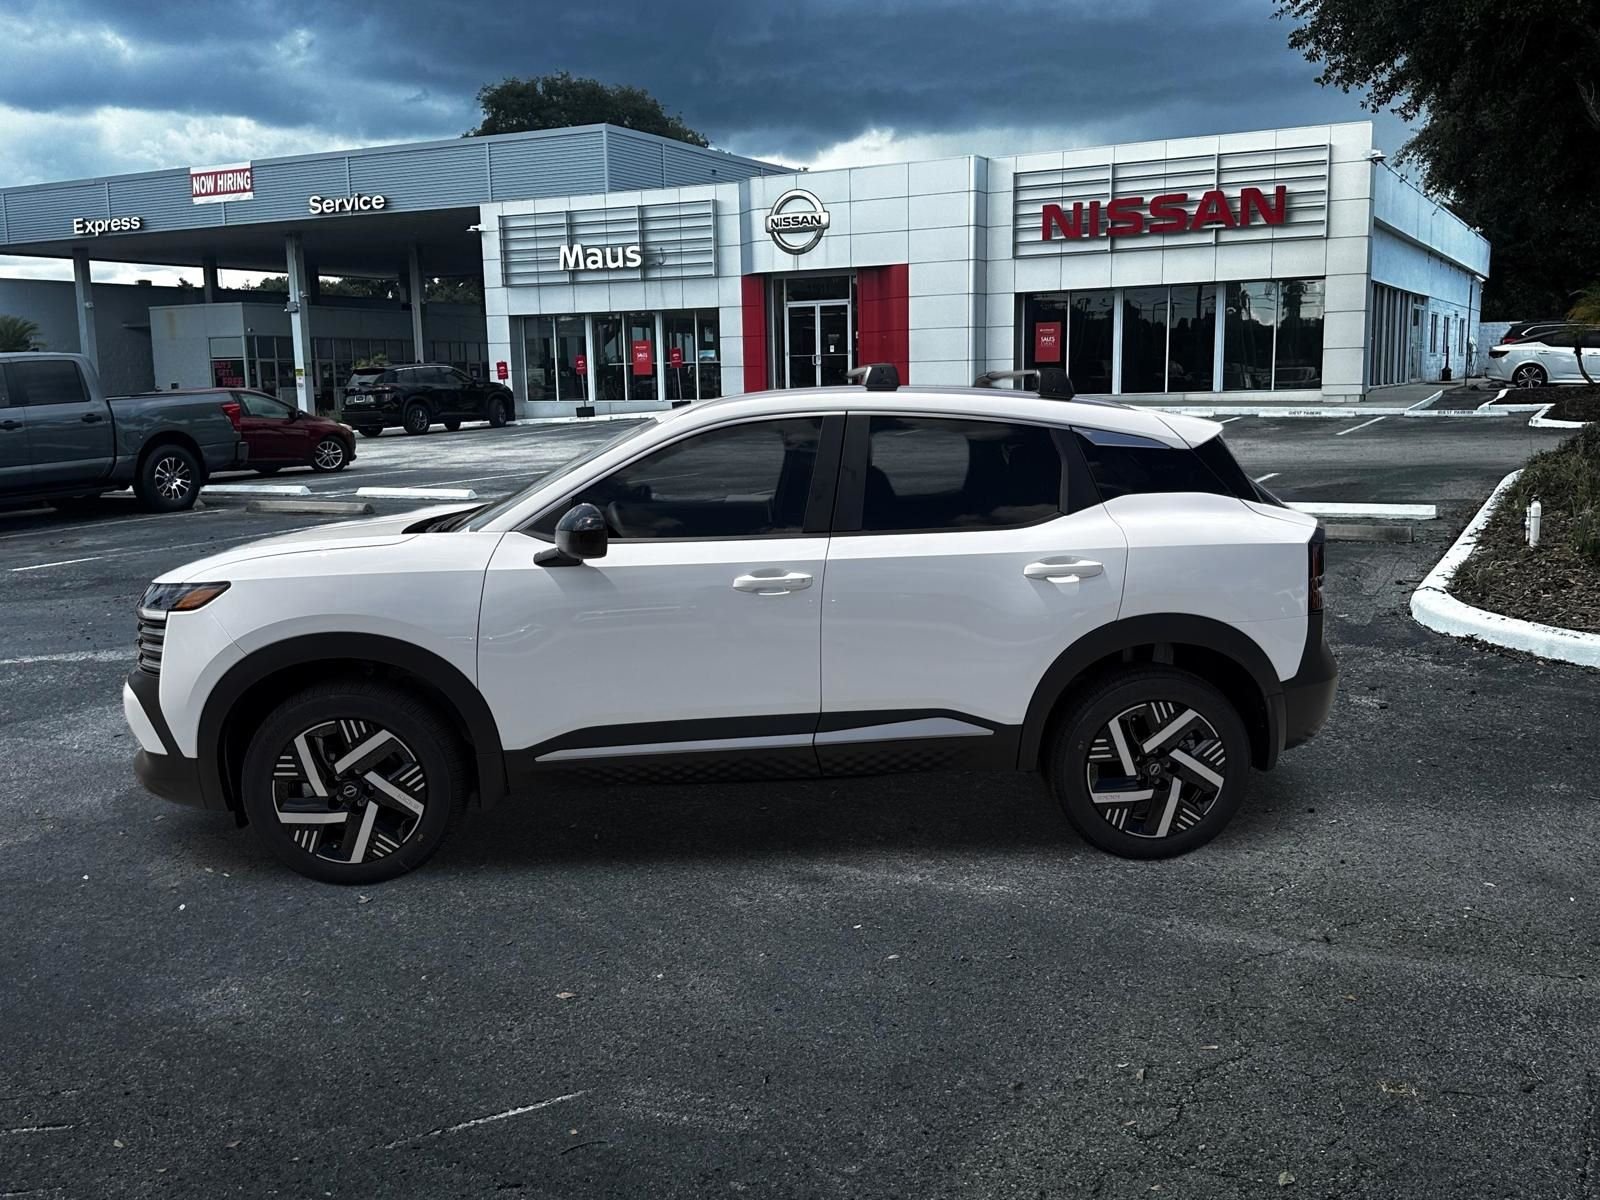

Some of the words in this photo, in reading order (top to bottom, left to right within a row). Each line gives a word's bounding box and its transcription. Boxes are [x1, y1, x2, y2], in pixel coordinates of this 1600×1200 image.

[192, 174, 215, 195] NOW
[217, 171, 251, 192] HIRING
[309, 192, 385, 214] Service
[1042, 185, 1287, 241] NISSAN
[73, 216, 141, 236] Express
[770, 215, 822, 228] NISSAN
[559, 243, 642, 271] Maus
[222, 377, 244, 386] FREE
